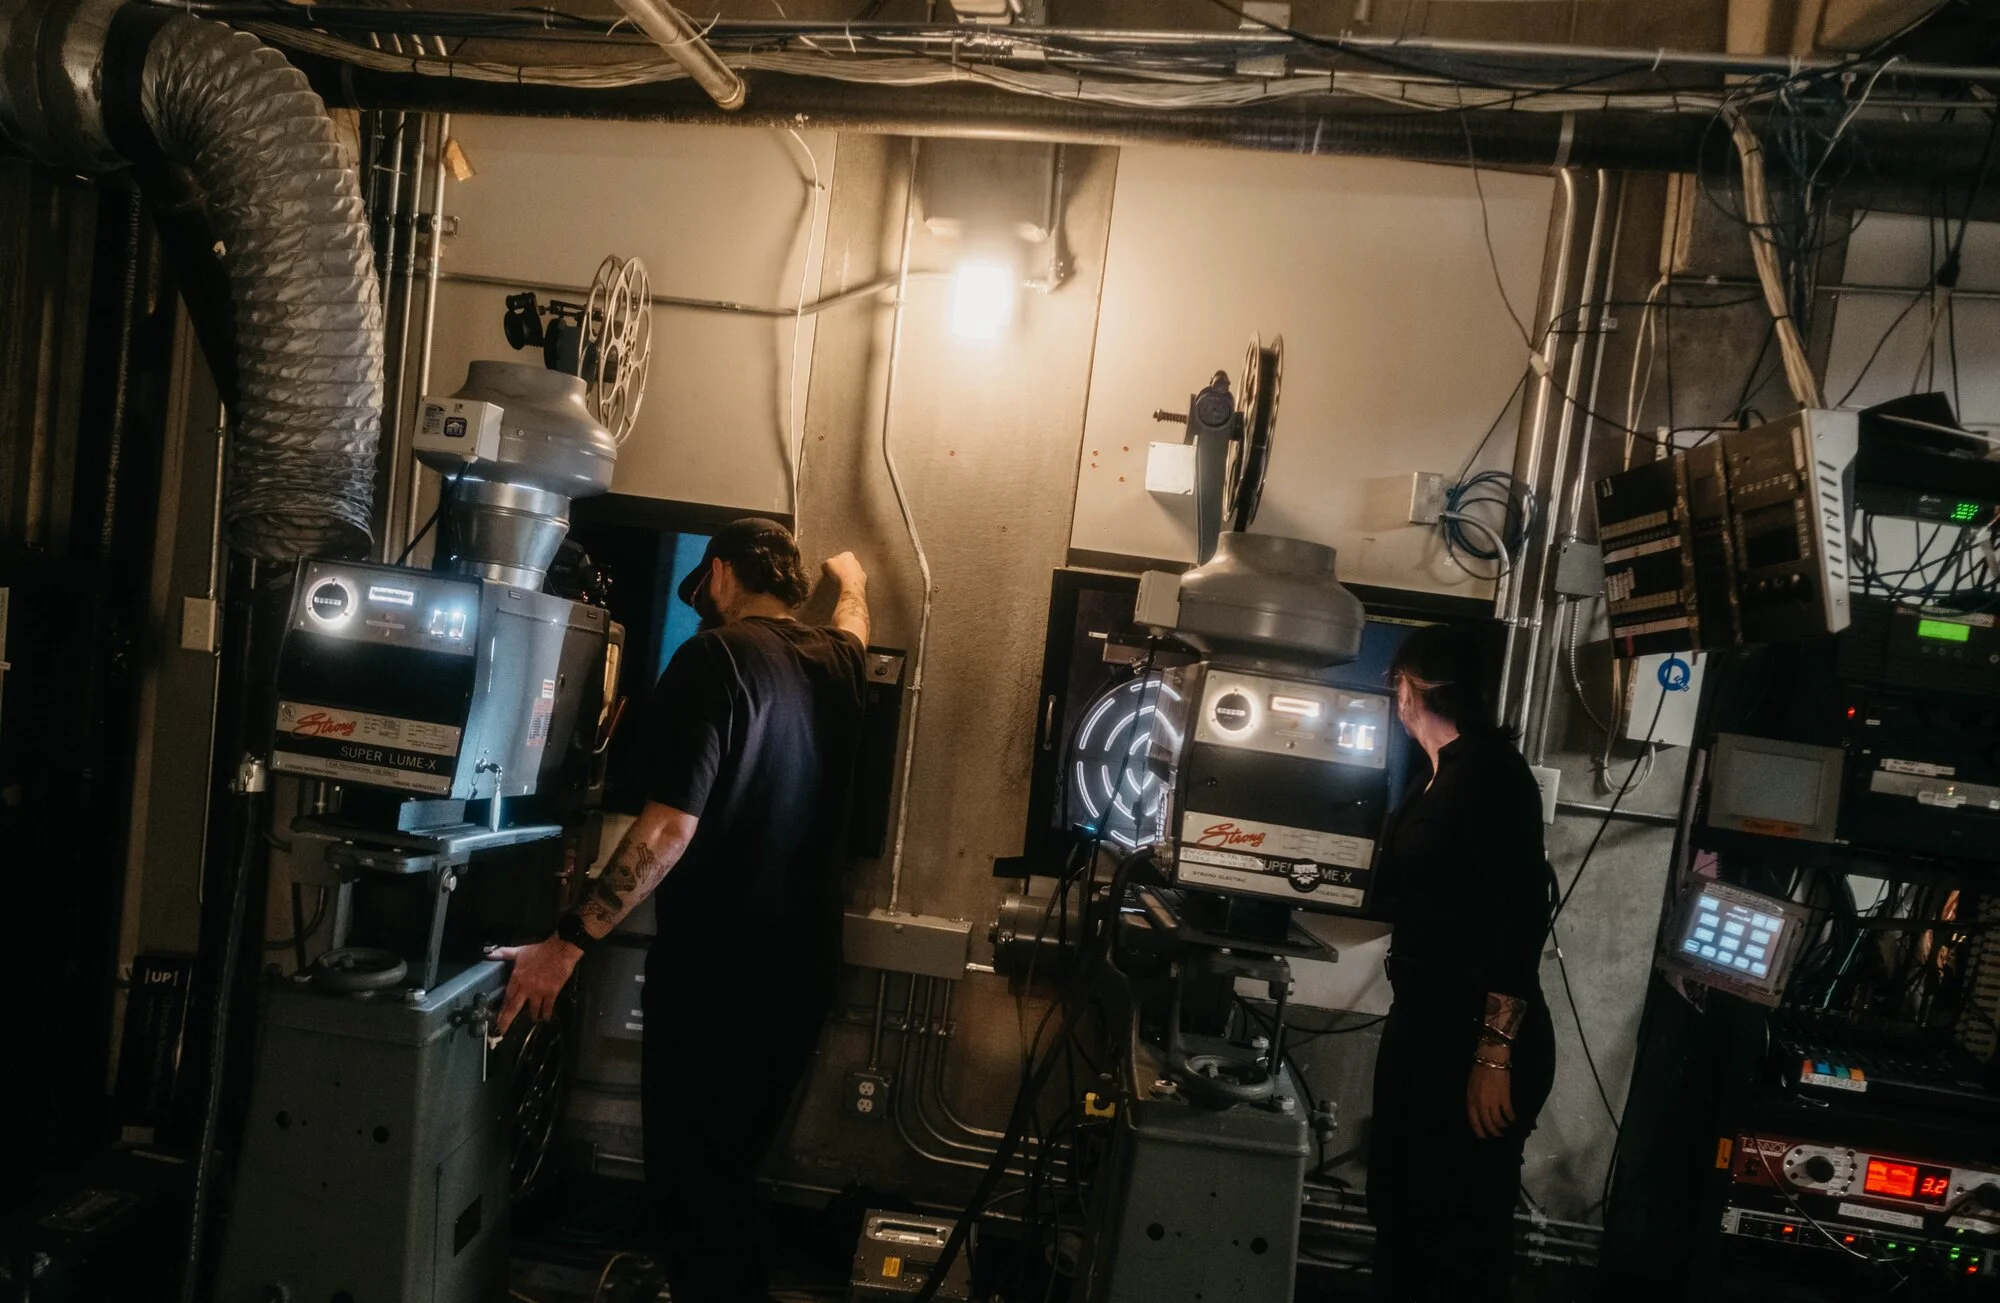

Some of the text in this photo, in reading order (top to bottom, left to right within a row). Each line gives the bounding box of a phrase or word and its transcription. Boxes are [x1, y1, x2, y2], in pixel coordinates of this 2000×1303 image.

[292, 712, 357, 737] Strong
[340, 745, 437, 770] SUPER LUME-X
[1196, 823, 1266, 849] Strong
[1920, 1176, 1948, 1194] 3.2
